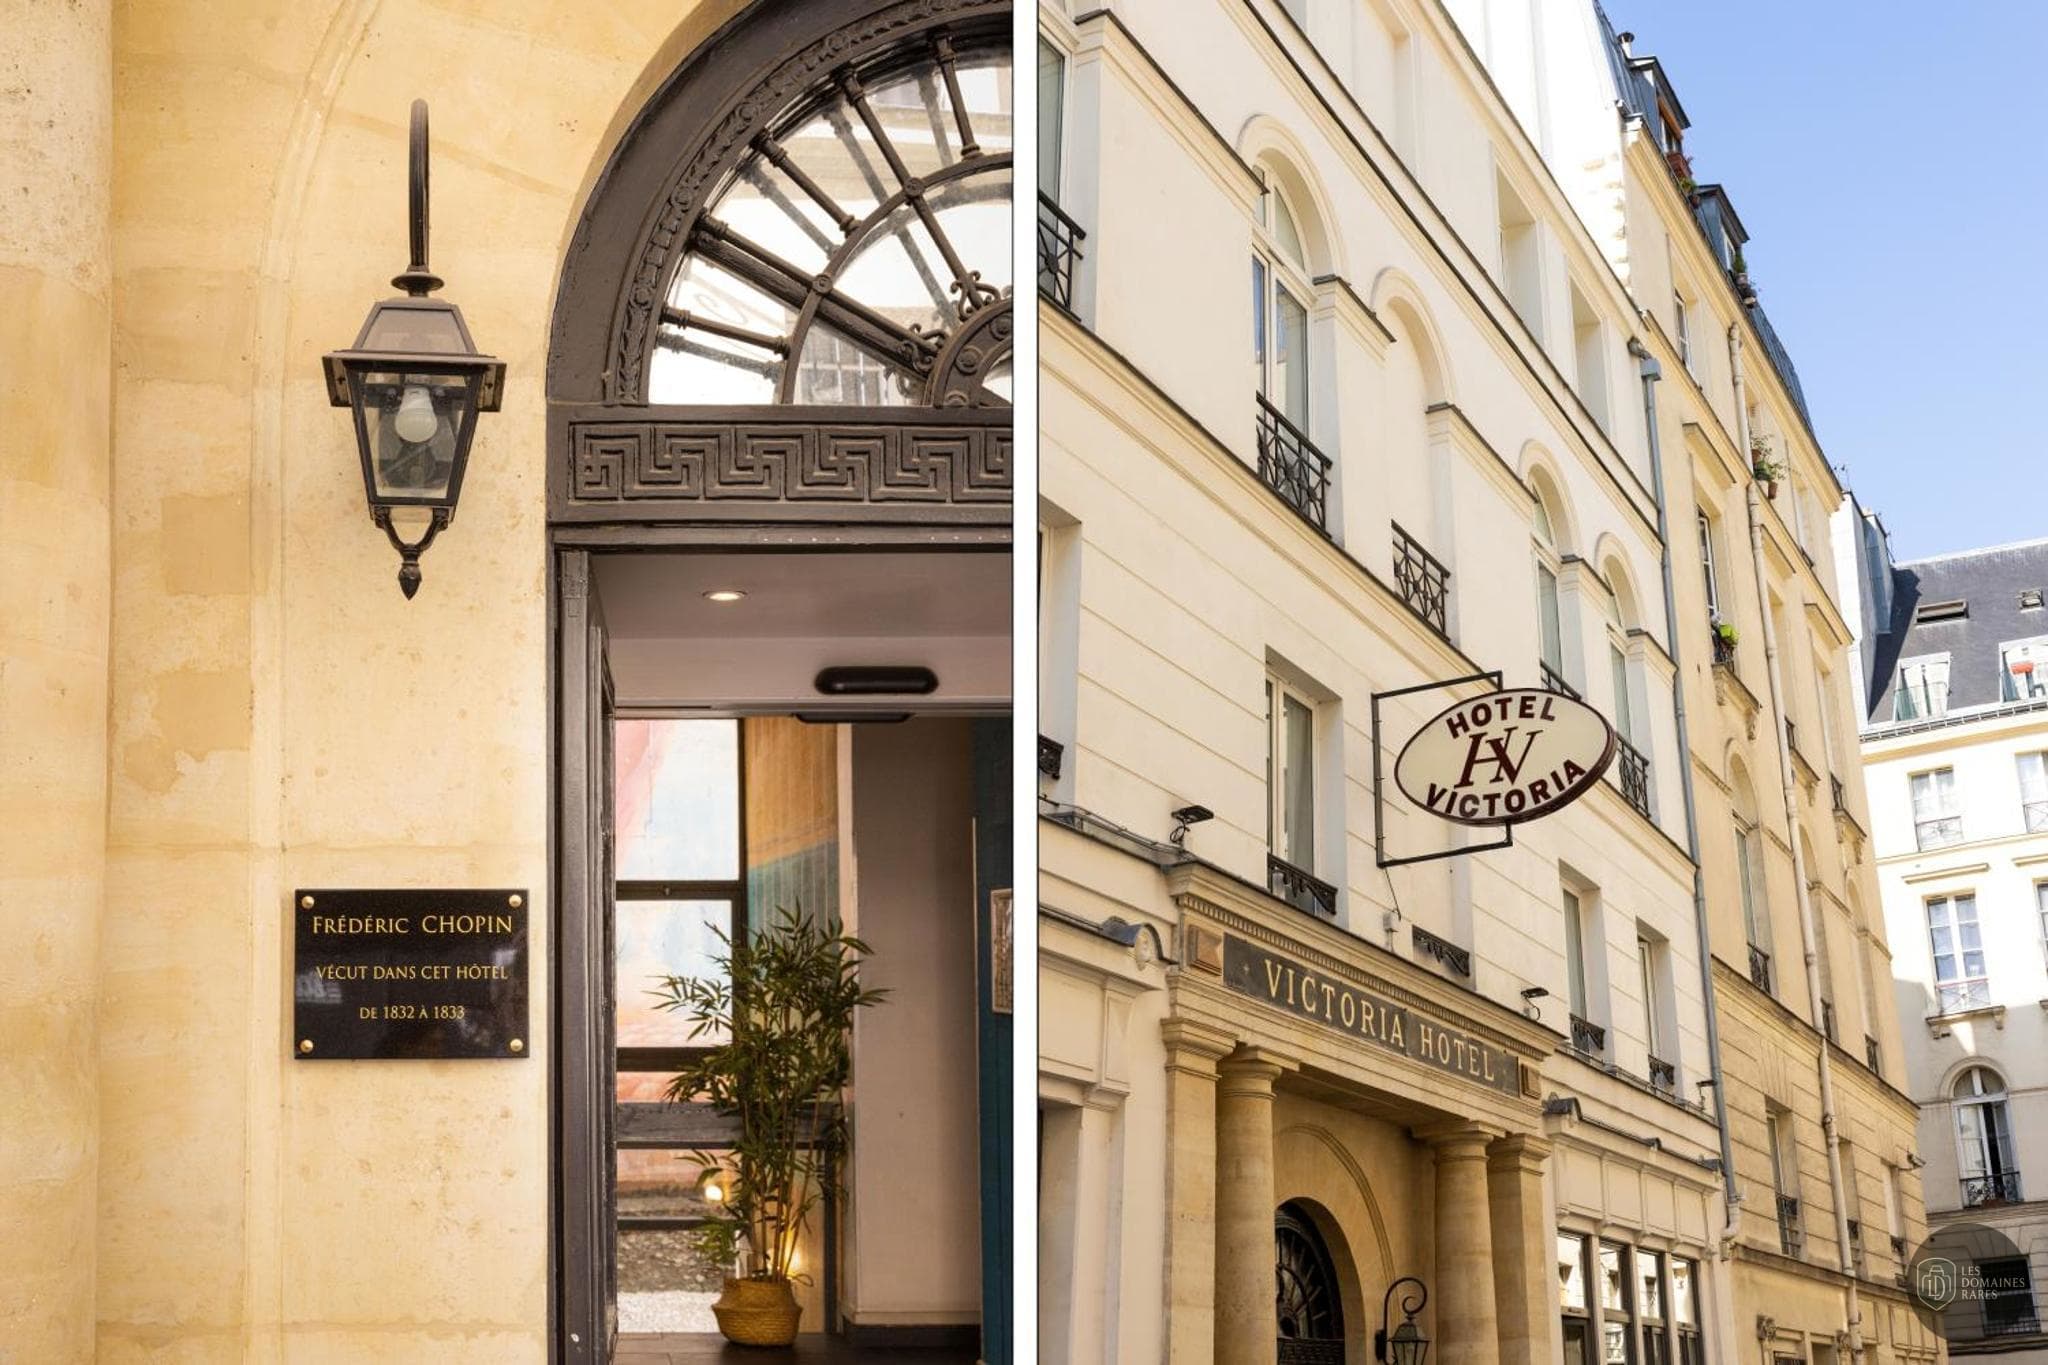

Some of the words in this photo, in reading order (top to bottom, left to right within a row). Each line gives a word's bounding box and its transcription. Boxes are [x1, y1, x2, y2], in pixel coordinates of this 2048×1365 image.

[1446, 696, 1556, 739] HOTEL
[1426, 759, 1586, 818] VICTORIA
[313, 915, 409, 934] FRÉDÉRIC
[422, 915, 513, 933] CHOPIN
[316, 964, 368, 980] VÉCUT
[373, 966, 416, 979] DANS
[421, 966, 451, 979] CET
[456, 963, 508, 979] HÔTEL
[359, 1007, 377, 1019] DE
[383, 1006, 415, 1019] 1832
[419, 1004, 428, 1019] À
[433, 1006, 465, 1019] 1833
[1264, 959, 1406, 1048] VICTORIA
[1419, 1024, 1495, 1081] HOTEL
